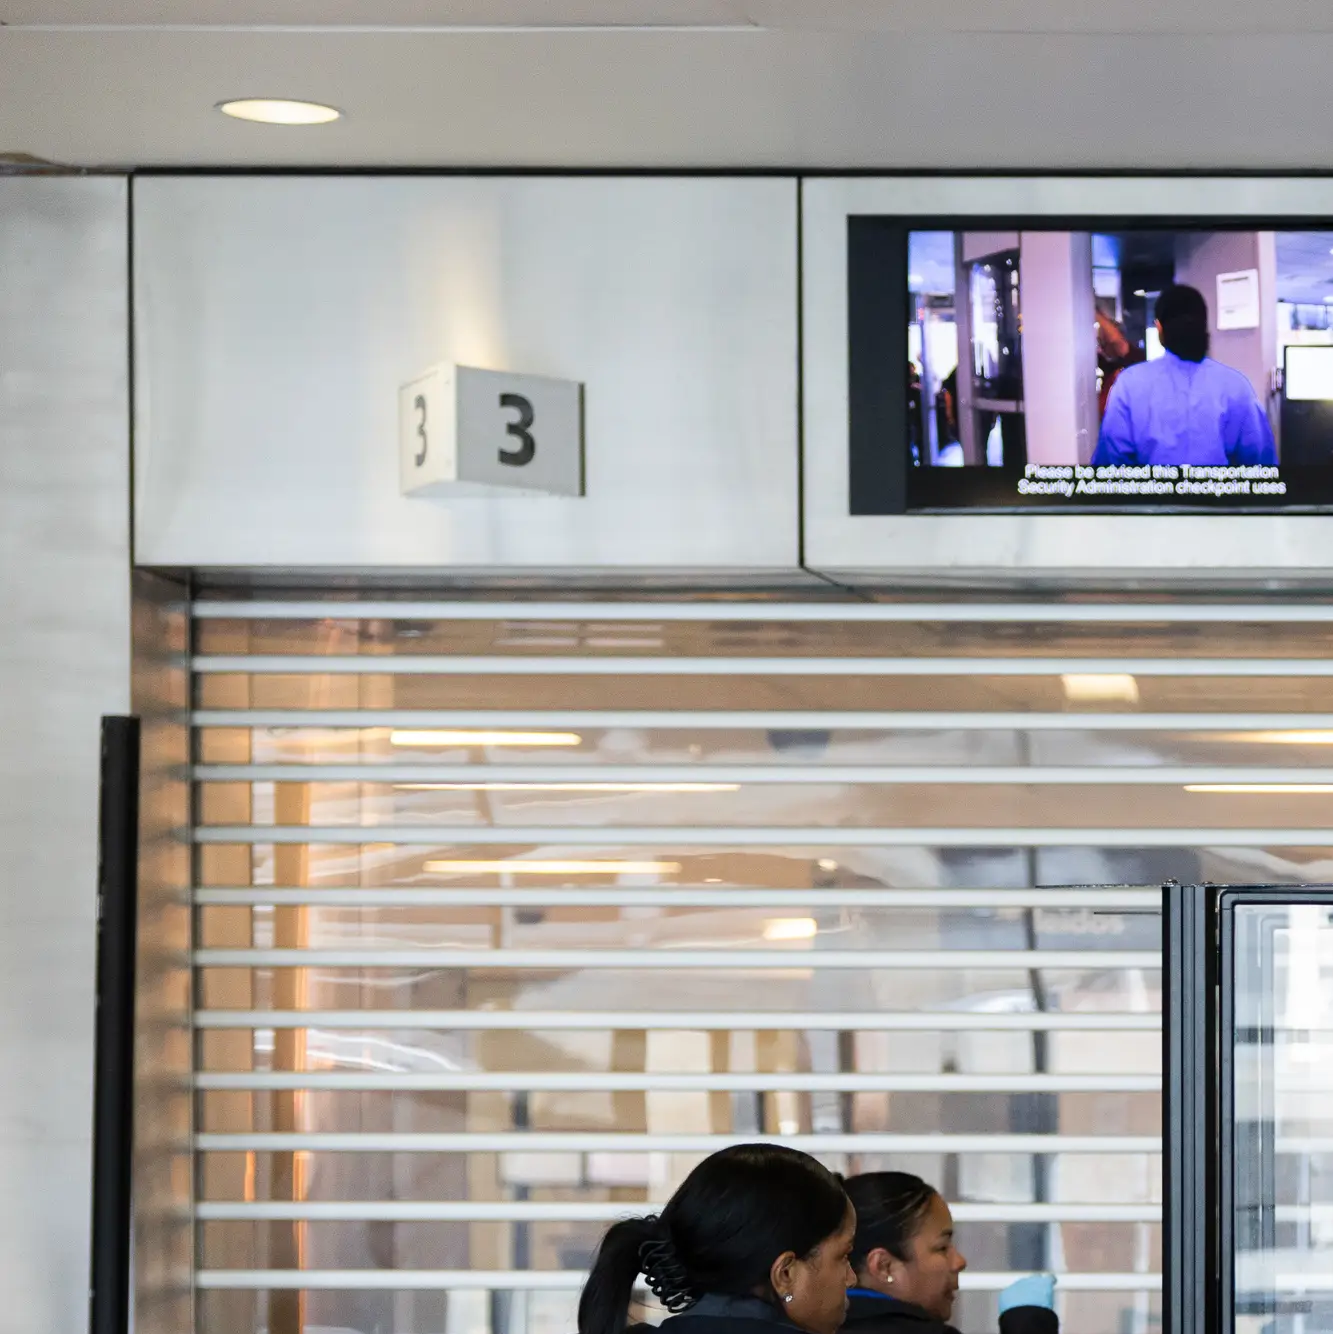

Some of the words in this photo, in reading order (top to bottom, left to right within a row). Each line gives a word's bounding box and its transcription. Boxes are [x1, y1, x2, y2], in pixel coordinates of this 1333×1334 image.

[415, 394, 427, 467] 3
[498, 393, 536, 467] 3
[1017, 479, 1074, 497] Security
[1075, 479, 1174, 494] Administration
[1175, 479, 1250, 497] checkpoint
[1251, 481, 1287, 494] uses
[1024, 464, 1073, 479] Please
[1075, 464, 1095, 479] be
[1096, 464, 1150, 479] advised
[1152, 464, 1179, 479] this
[1180, 464, 1280, 481] Transportation
